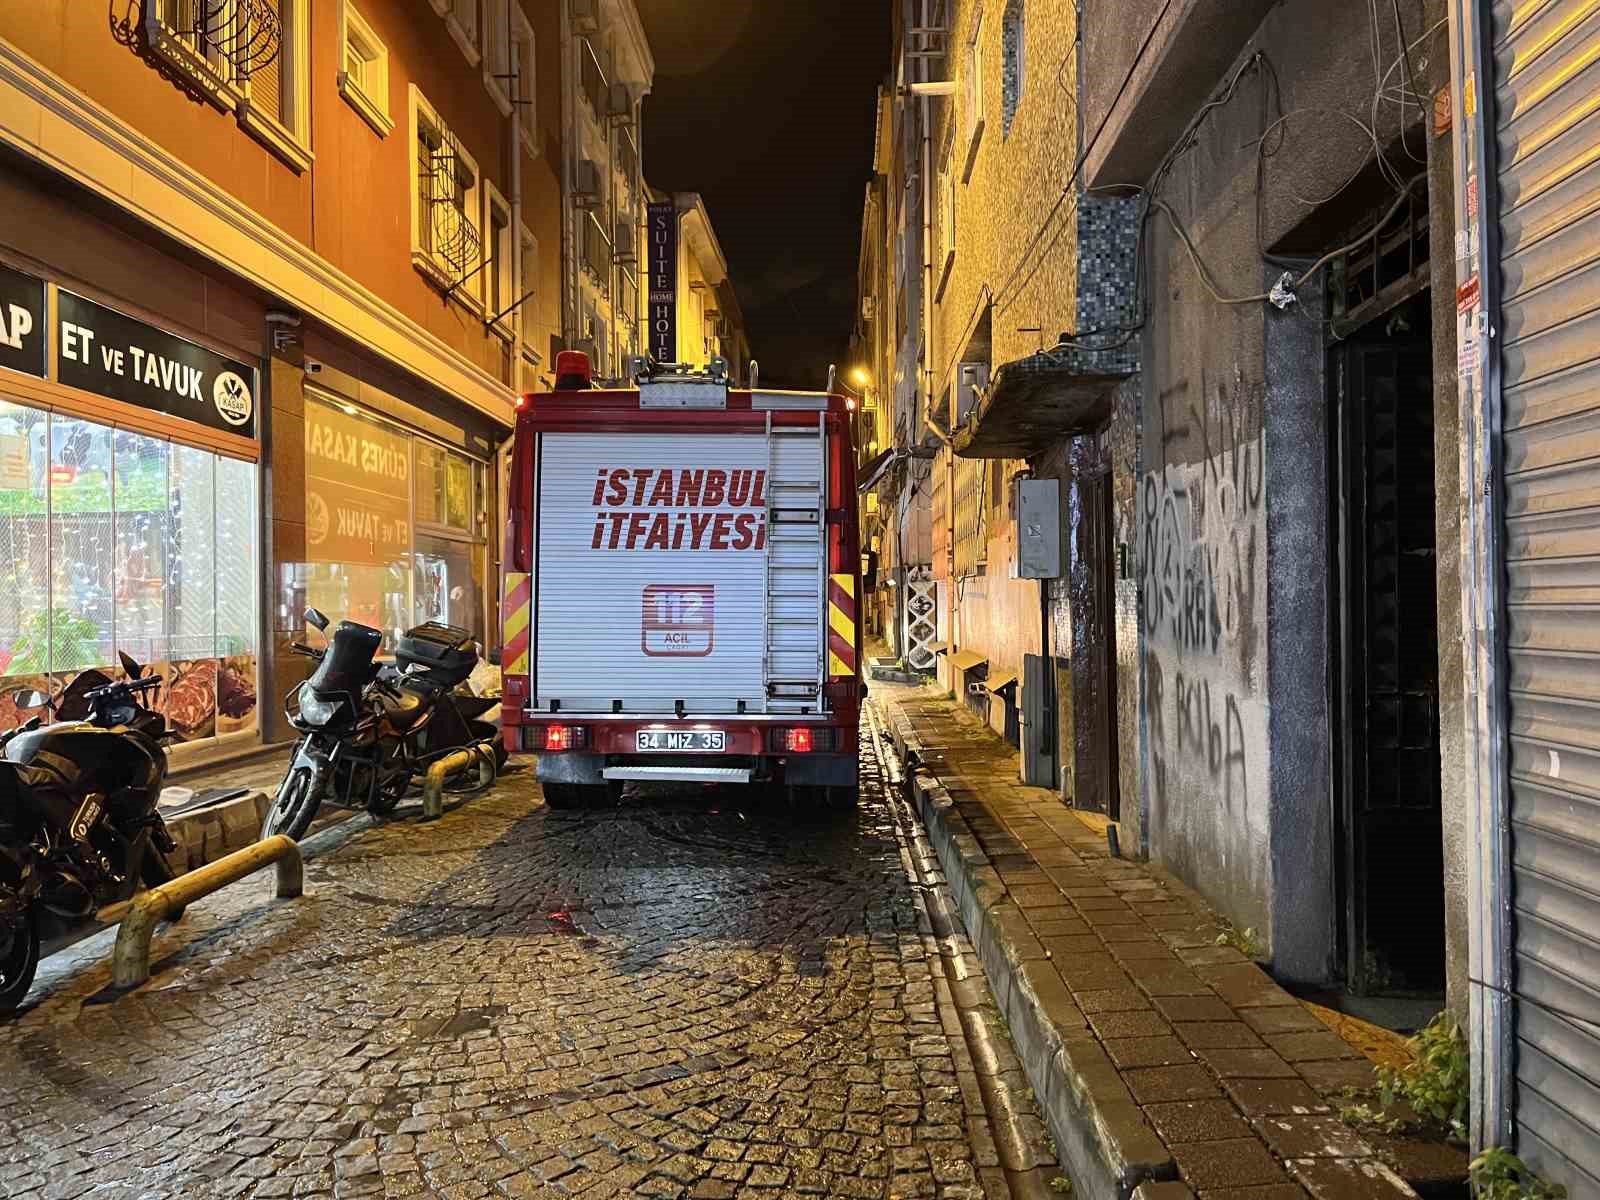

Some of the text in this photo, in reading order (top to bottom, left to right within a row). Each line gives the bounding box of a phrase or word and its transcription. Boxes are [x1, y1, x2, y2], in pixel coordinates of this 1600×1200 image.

[655, 215, 668, 288] SUITE
[61, 320, 204, 401] ET VE TAVUK
[655, 305, 669, 364] HOTE
[655, 591, 704, 624] 112
[639, 733, 722, 749] 34 MIZ 35
